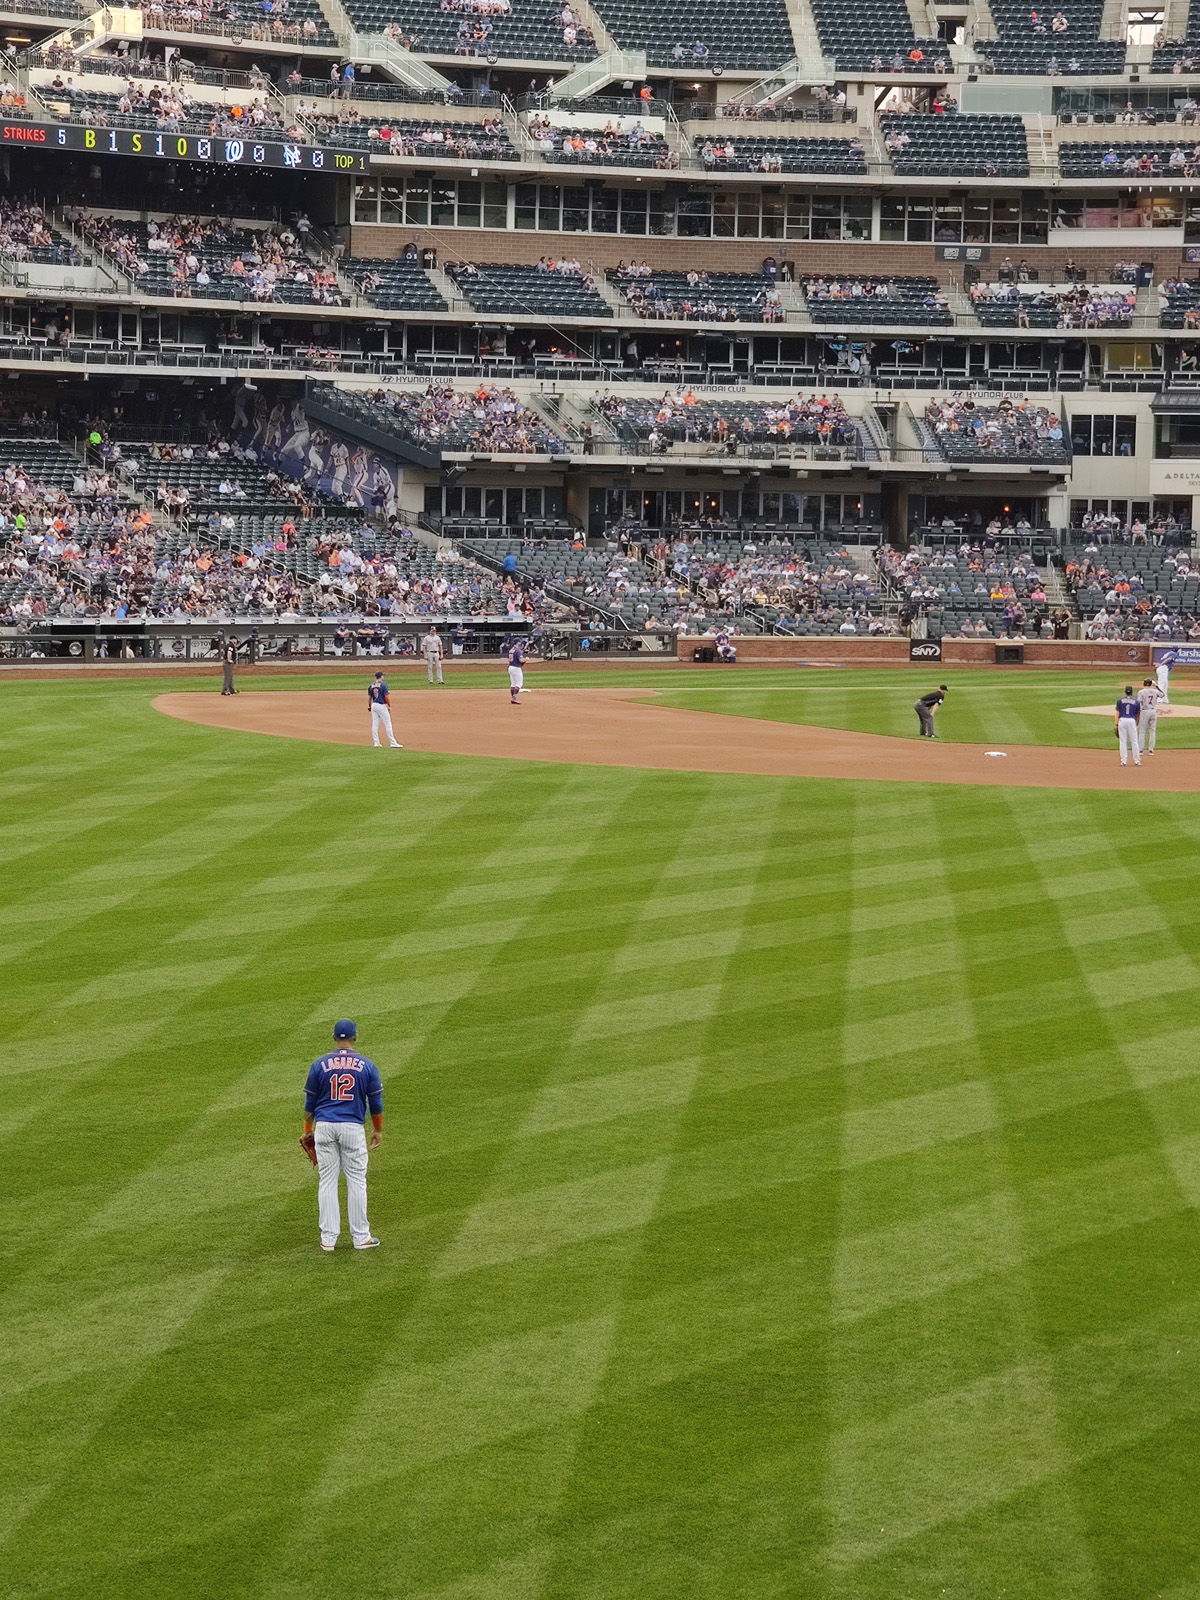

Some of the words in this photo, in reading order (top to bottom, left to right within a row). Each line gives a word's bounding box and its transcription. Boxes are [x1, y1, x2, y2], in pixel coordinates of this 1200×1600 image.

[3, 126, 46, 142] STRIKES
[58, 129, 66, 145] 5
[85, 129, 96, 148] B
[109, 131, 118, 152] 1
[132, 134, 142, 152] S
[156, 135, 165, 156] 1
[197, 139, 211, 159] 0
[253, 145, 265, 162] 0
[312, 151, 324, 167] 0
[334, 155, 354, 168] TOP
[359, 157, 365, 170] 1
[911, 647, 936, 656] SNY
[1148, 695, 1154, 705] 7
[321, 1056, 365, 1073] LAGARES
[330, 1073, 355, 1101] 12
